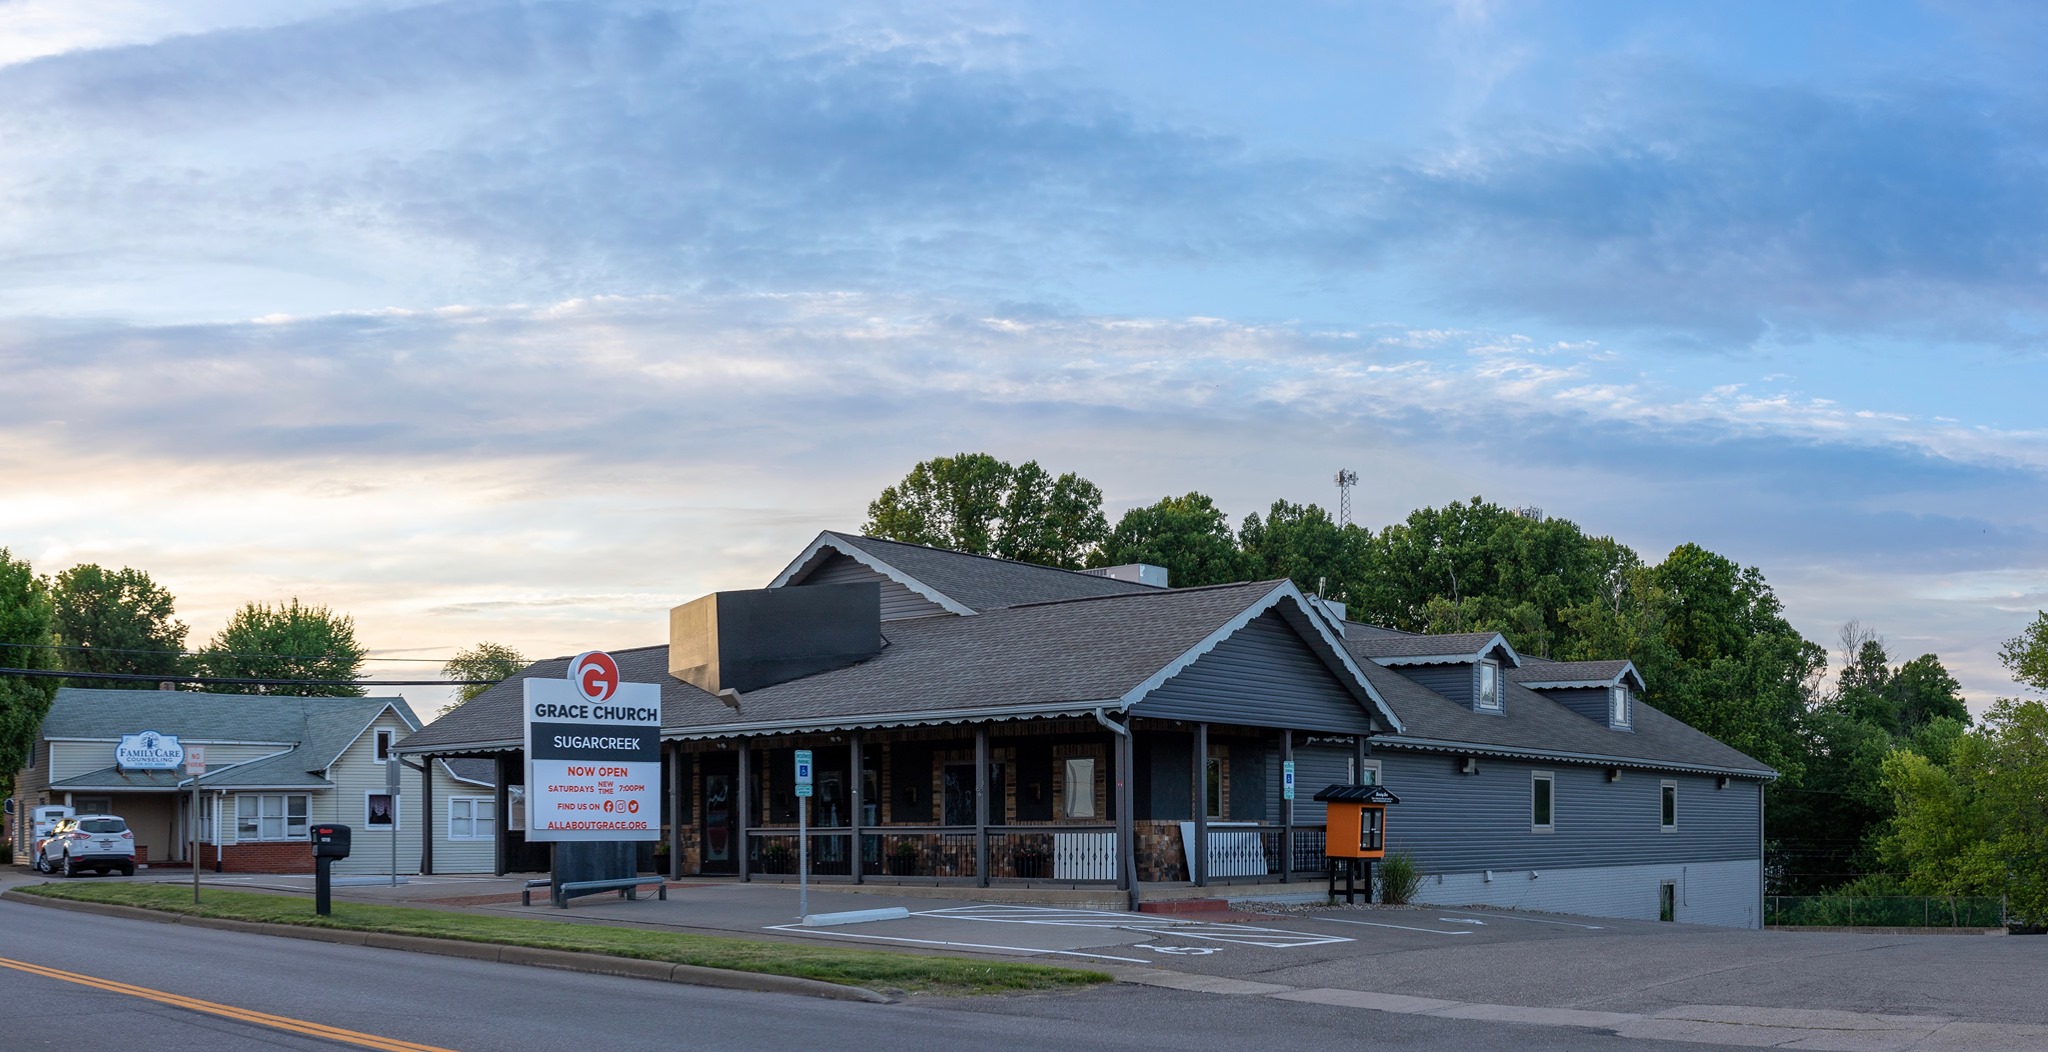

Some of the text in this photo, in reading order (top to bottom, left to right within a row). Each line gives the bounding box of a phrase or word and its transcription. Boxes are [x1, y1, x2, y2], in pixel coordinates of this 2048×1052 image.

[535, 703, 658, 722] GRACE CHURCH
[553, 735, 641, 751] SUGARCREEK
[567, 766, 629, 778] NOW OPEN
[548, 785, 595, 793] SATURDAYS
[557, 803, 601, 811] FIND US ON
[547, 821, 648, 830] ALLABOUTGRACE.ORG
